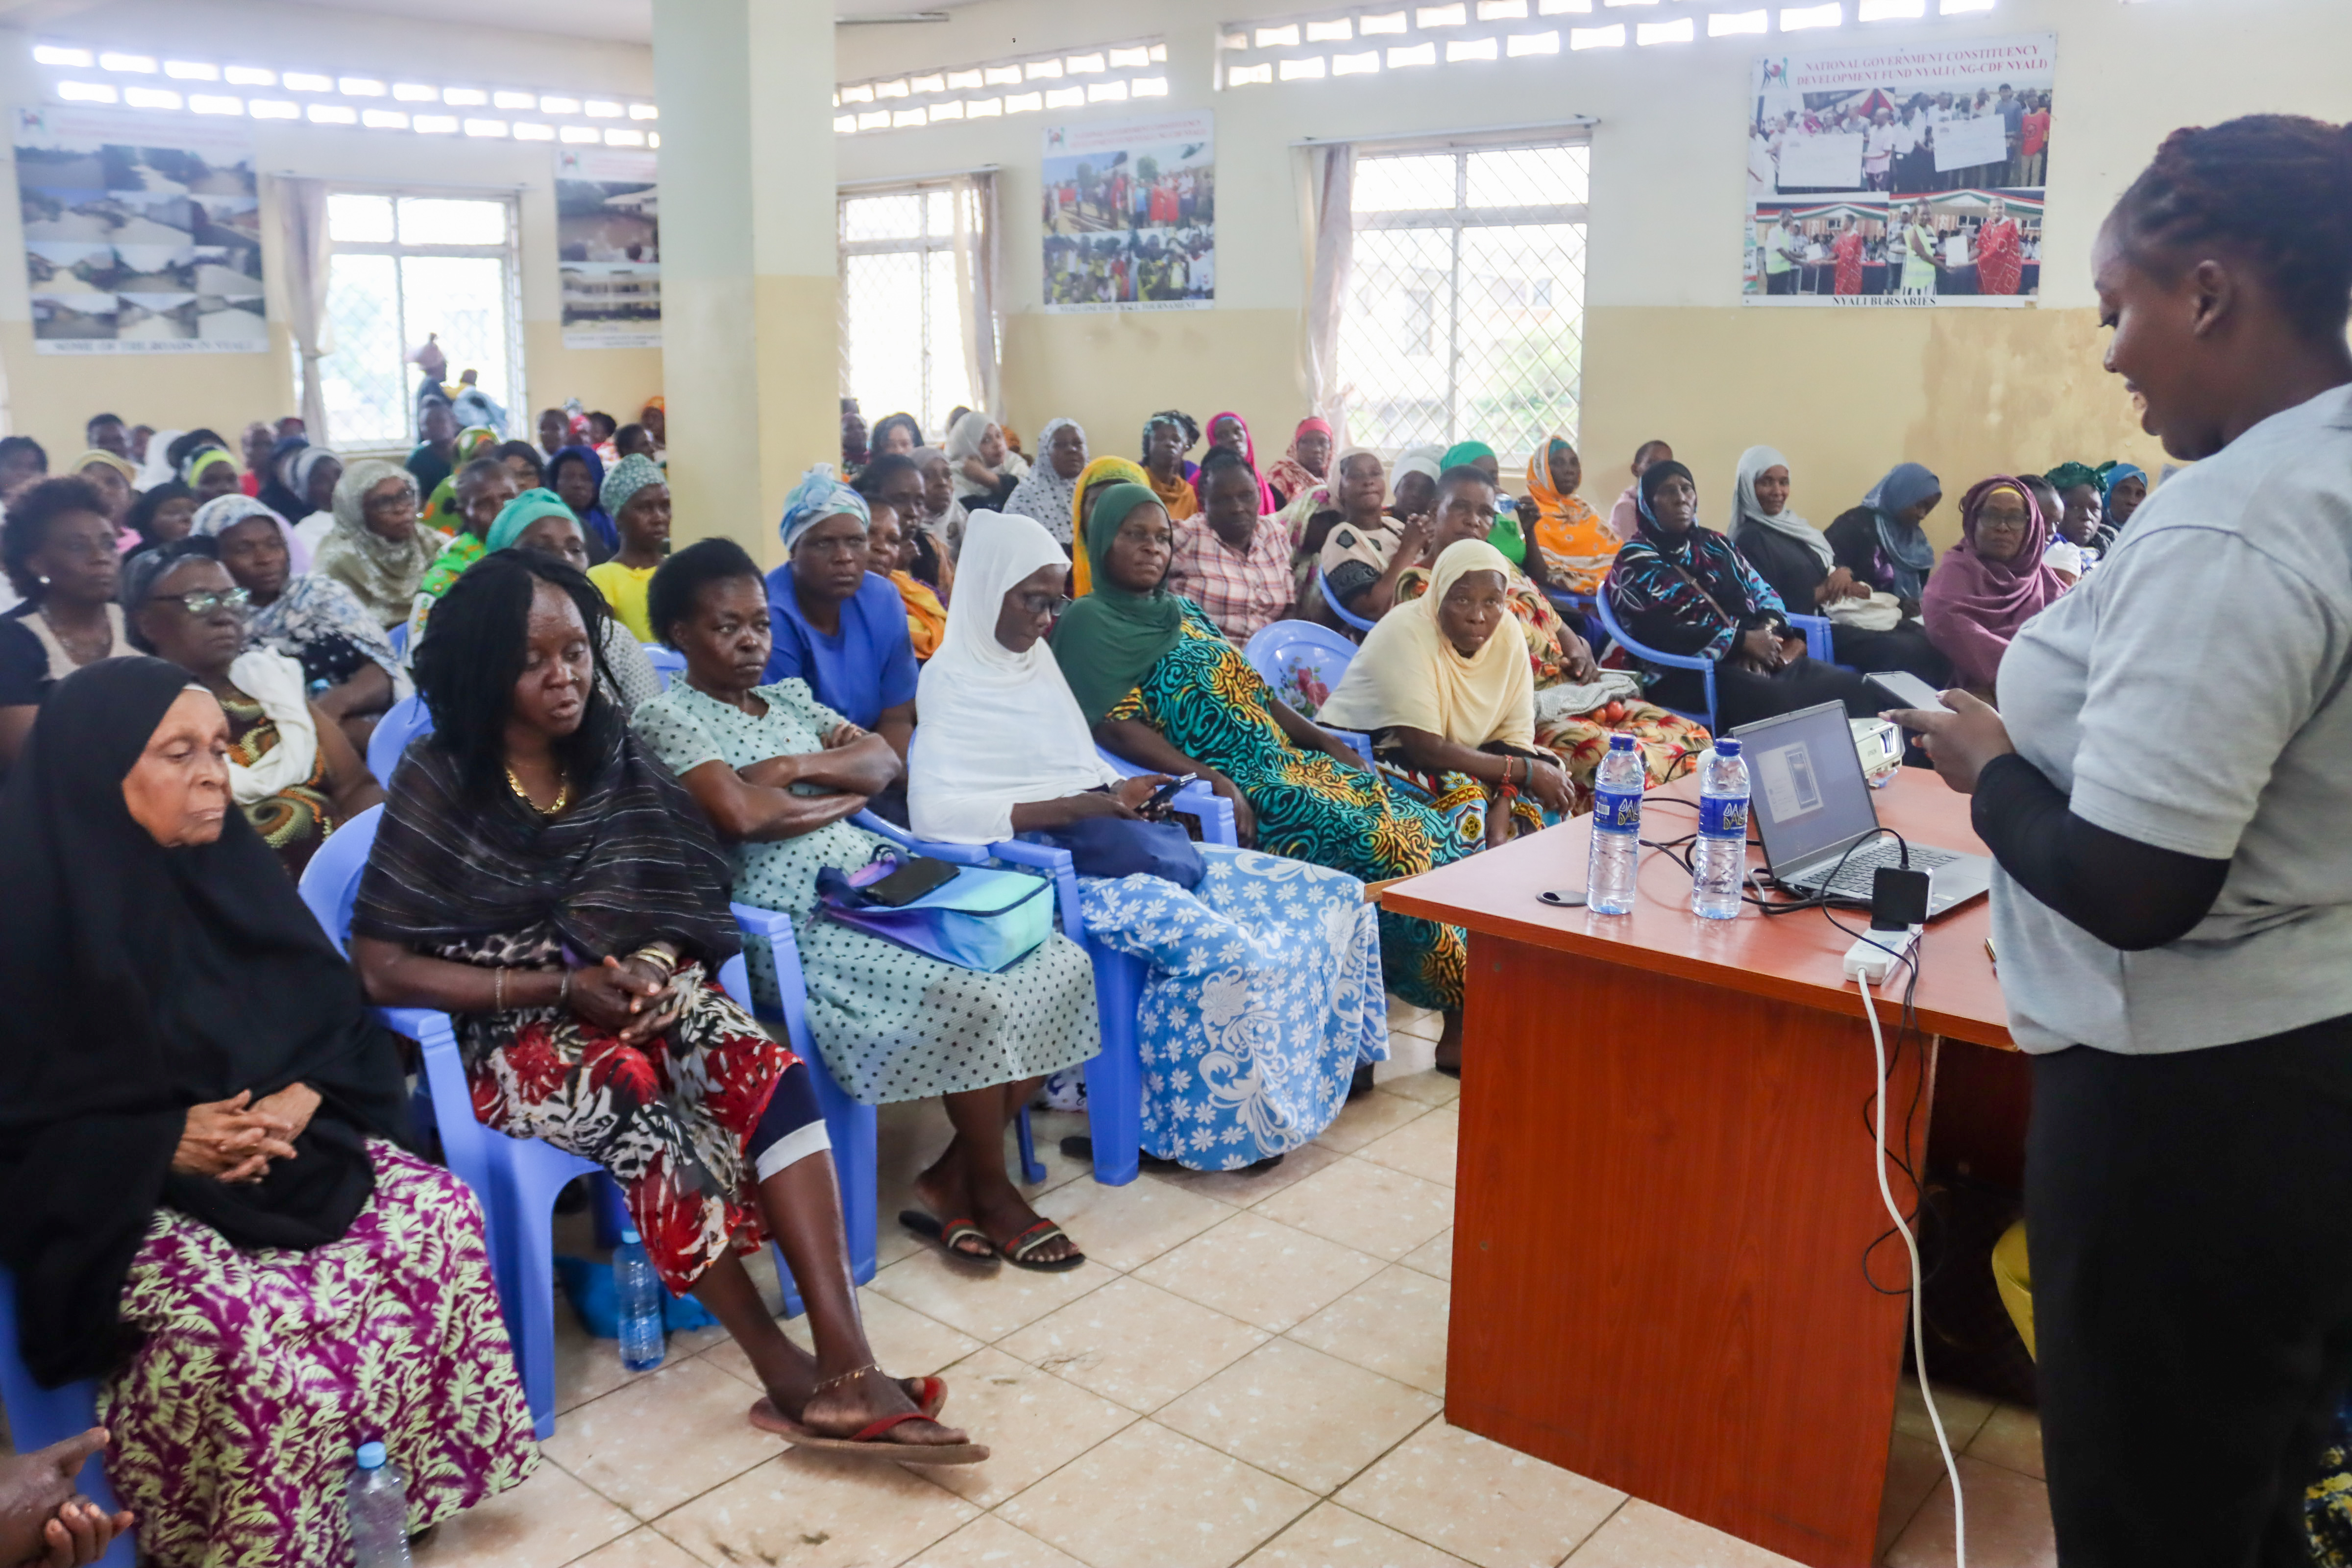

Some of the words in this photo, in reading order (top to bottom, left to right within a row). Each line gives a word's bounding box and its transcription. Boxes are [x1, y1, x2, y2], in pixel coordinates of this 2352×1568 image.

[1806, 58, 1858, 71] NATIONAL
[1863, 53, 1942, 67] GOVERNMENT
[1947, 45, 2039, 61] CONSTITUENCY
[1797, 71, 1878, 85] DEVELOPMENT
[1882, 69, 1911, 80] FUND
[1915, 66, 1949, 76] NYALI
[1960, 61, 2004, 74] NG-CDF
[2008, 58, 2048, 70] NYALI)
[1833, 297, 1867, 306] NYALI
[1871, 296, 1936, 306] BURSARIES
